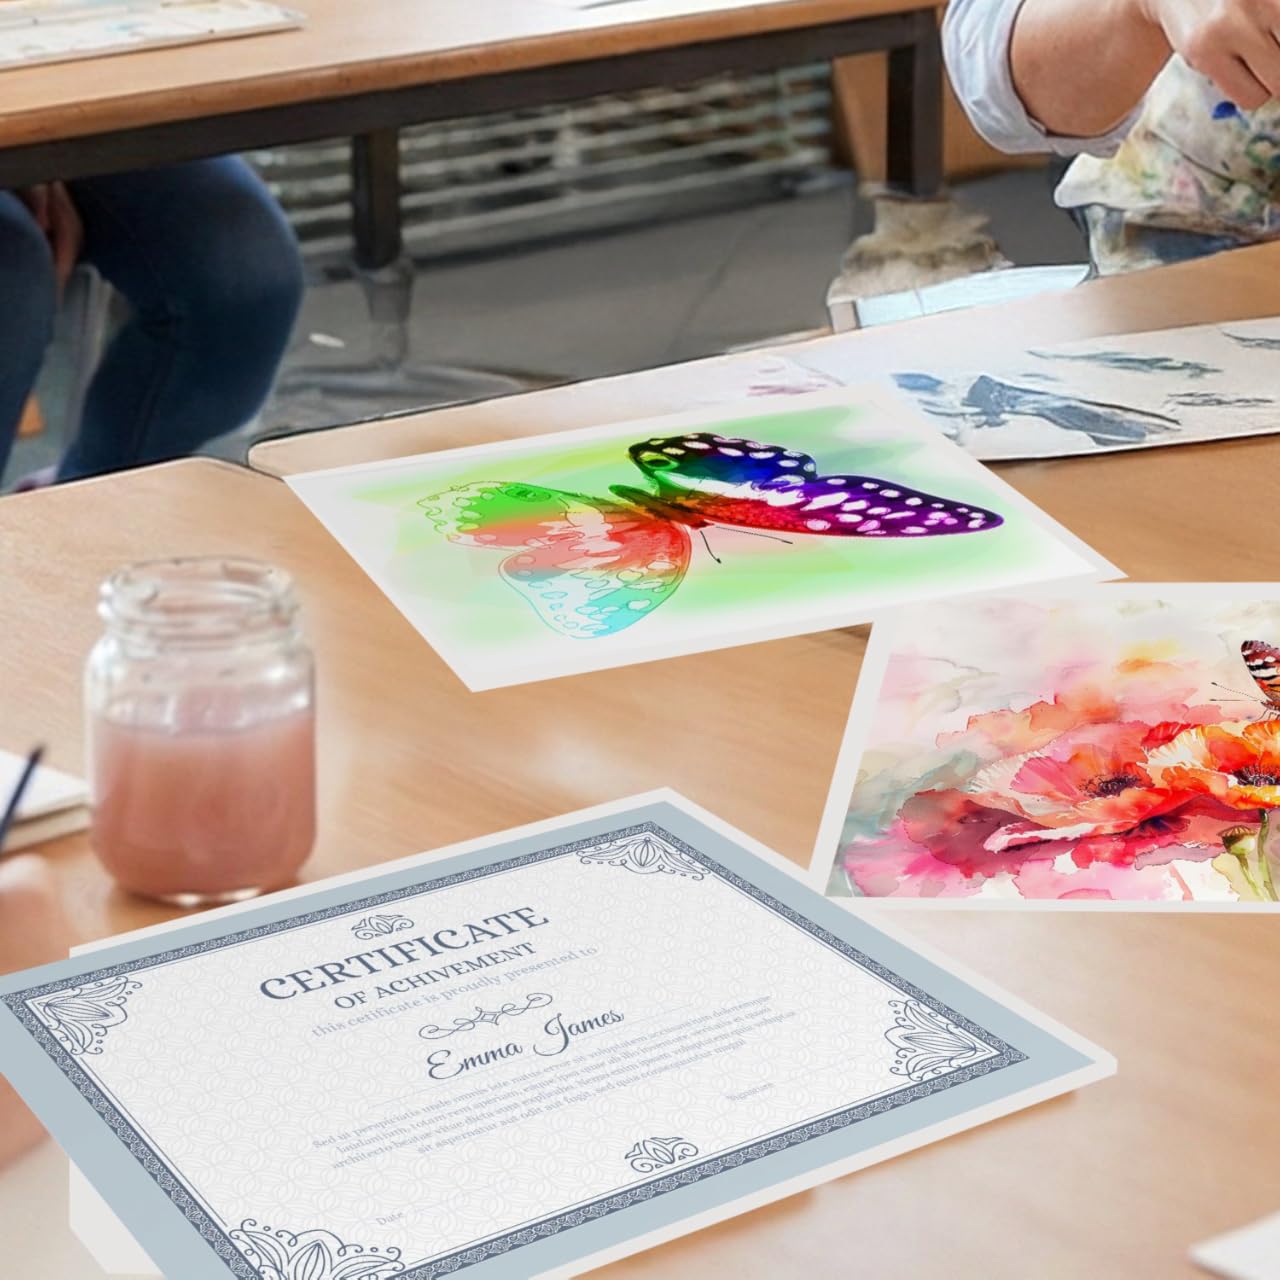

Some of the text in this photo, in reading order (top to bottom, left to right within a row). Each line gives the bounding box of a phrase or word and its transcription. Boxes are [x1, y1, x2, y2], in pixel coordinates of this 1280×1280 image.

[259, 906, 549, 999] CERTIFICATE
[333, 942, 536, 1008] OF ACHIVEMENT
[310, 1021, 347, 1037] this
[420, 993, 440, 1004] is
[438, 974, 501, 1001] proudly
[502, 949, 580, 982] presented
[577, 947, 598, 957] to
[426, 1009, 624, 1079] Emma James
[374, 1211, 403, 1226] Date
